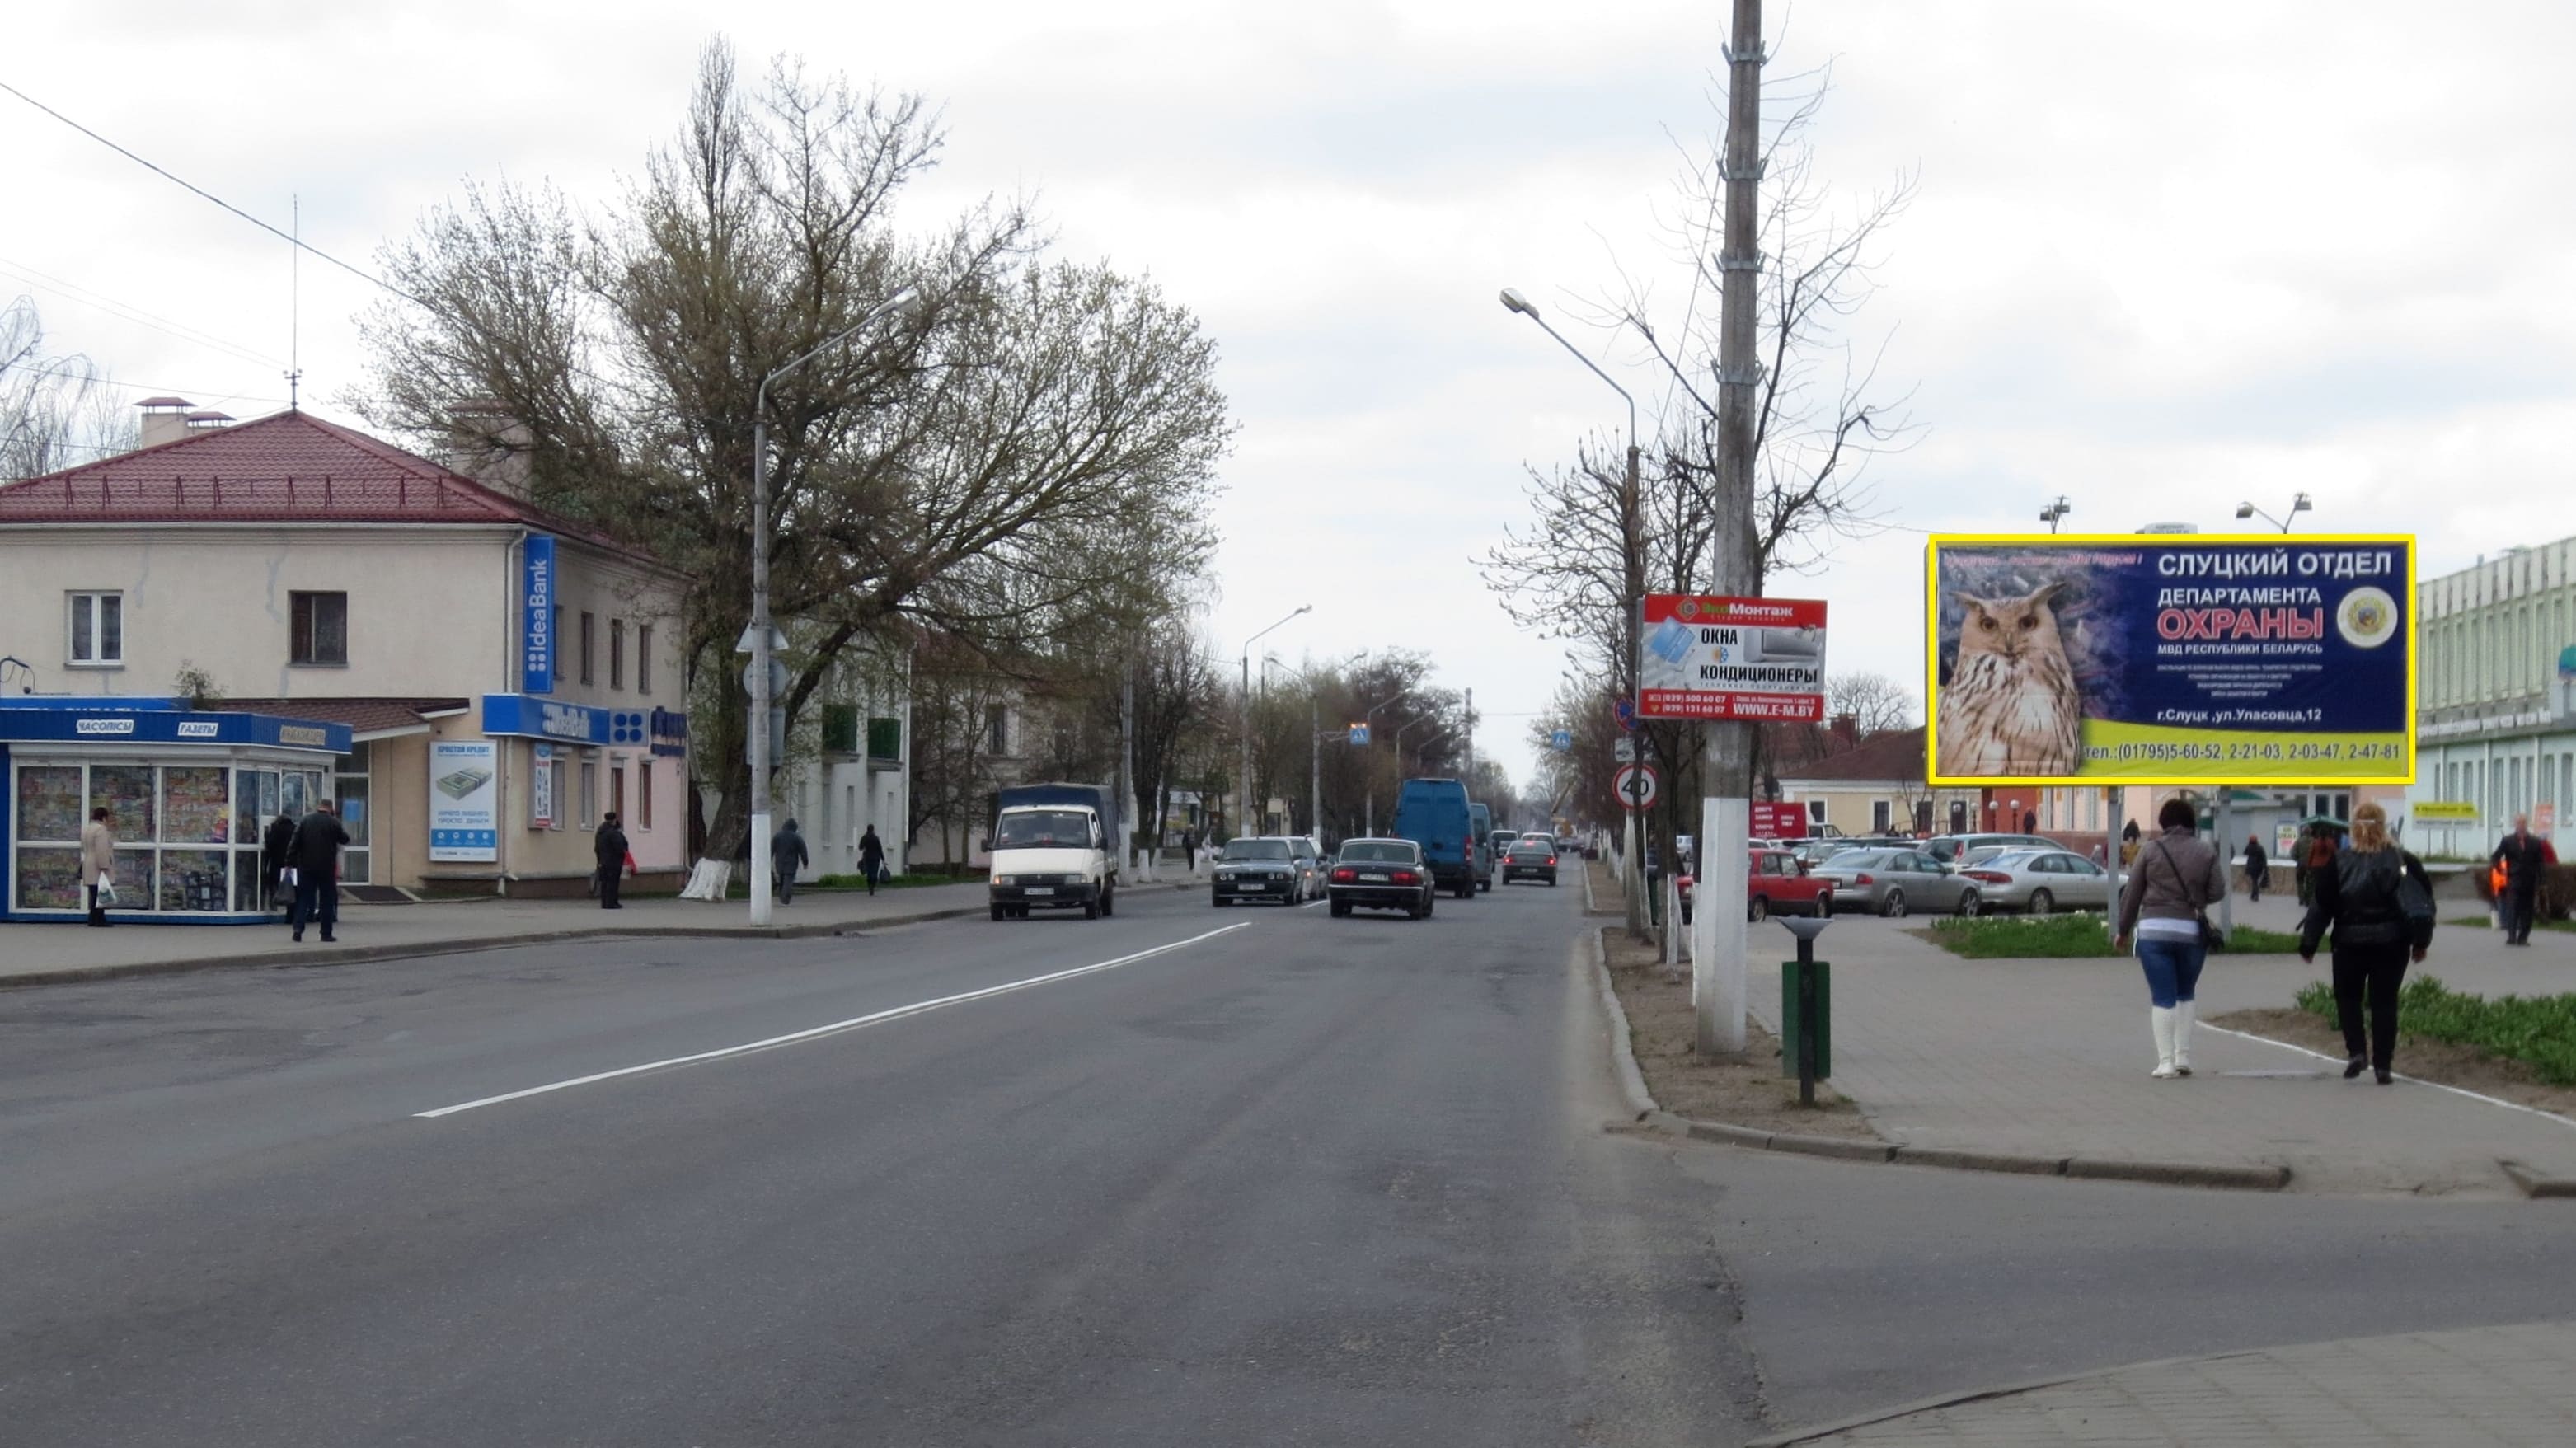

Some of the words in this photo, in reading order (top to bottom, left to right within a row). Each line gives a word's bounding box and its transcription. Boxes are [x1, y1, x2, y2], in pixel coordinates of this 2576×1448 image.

[2158, 548, 2288, 579] СЛУЦКИЙ
[2297, 552, 2391, 578] ОТДЕЛ
[2157, 588, 2321, 606] ДЕПАРТАМЕНТА
[2157, 607, 2323, 640] ОХРАНЫ
[1701, 628, 1738, 644] ОКНА
[2157, 644, 2183, 655] МВД
[2185, 644, 2259, 655] РЕСПУБЛИКИ
[2263, 644, 2323, 654] БЕЛАРУСЬ
[1700, 665, 1818, 683] КОНДИЦИОНЕРЫ
[1733, 703, 1814, 717] WWW.E-M.BY
[179, 724, 217, 734] ГАЗЕТЫ
[2348, 744, 2400, 760] 2-47-81
